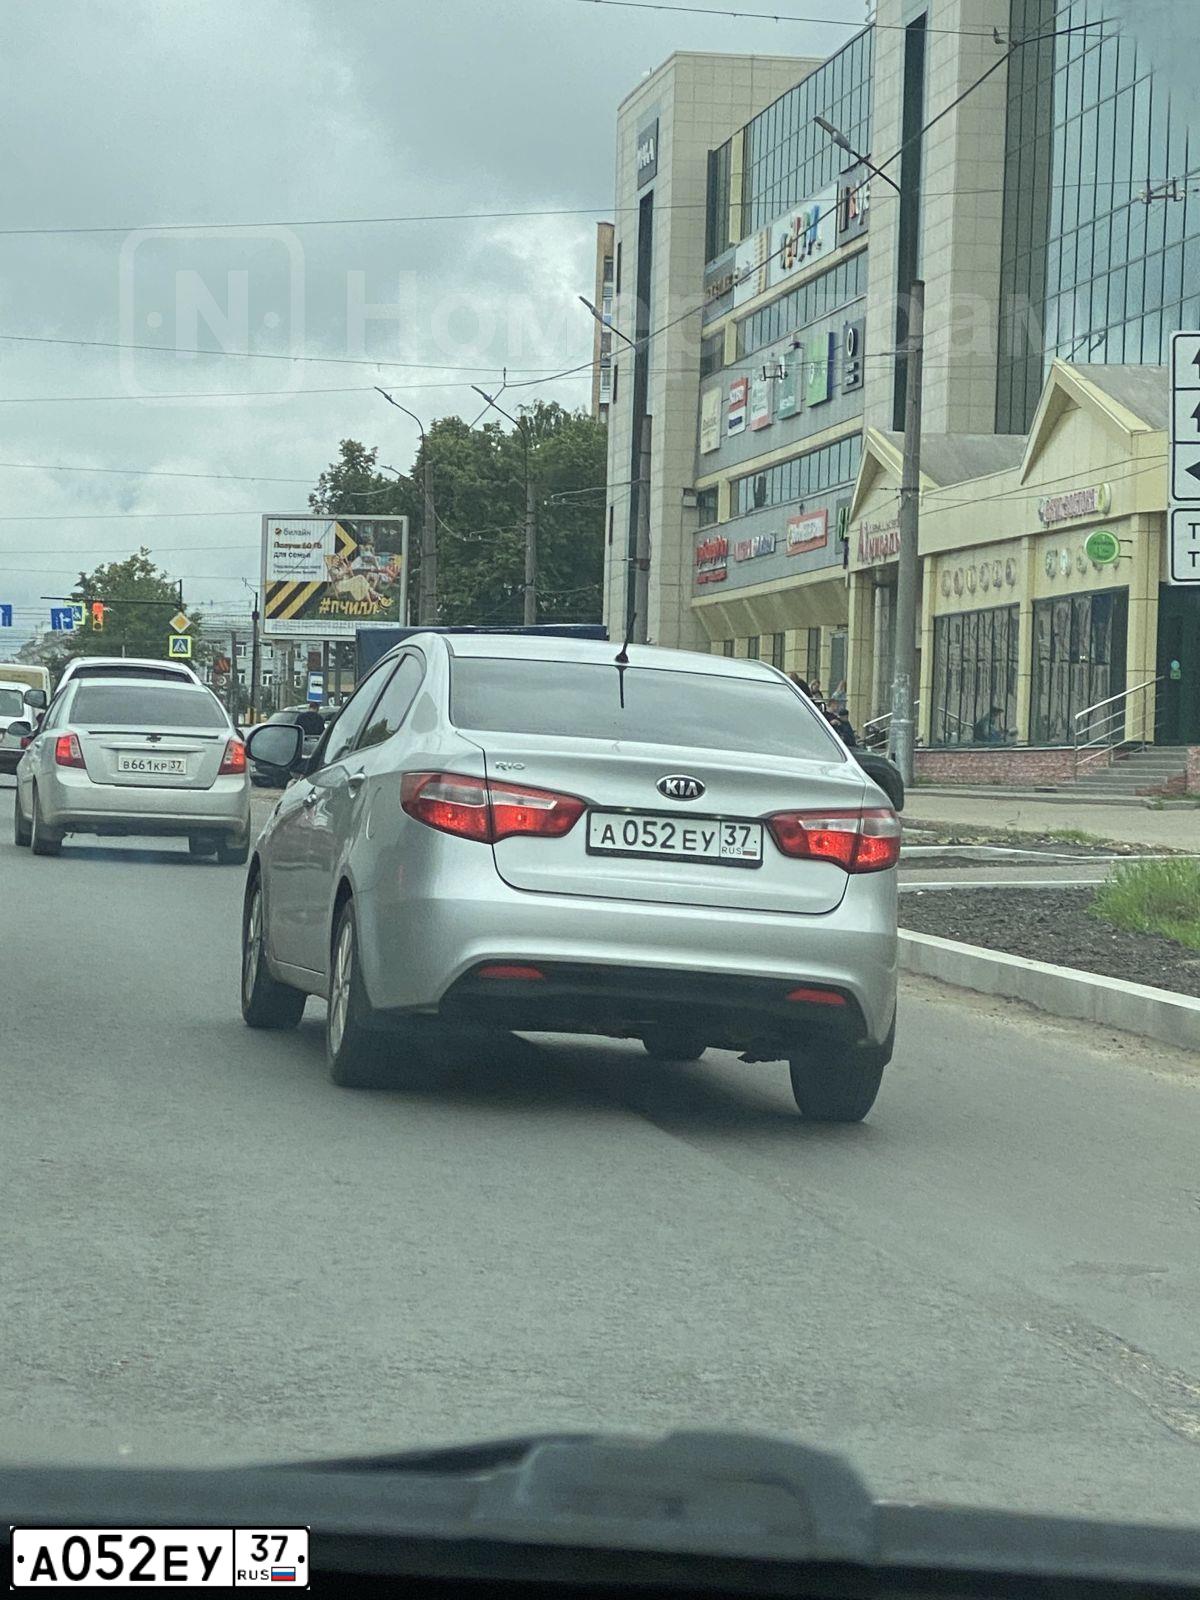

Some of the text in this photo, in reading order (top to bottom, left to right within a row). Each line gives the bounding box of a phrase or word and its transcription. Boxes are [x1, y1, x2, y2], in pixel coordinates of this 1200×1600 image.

[283, 527, 311, 536] билайн
[495, 761, 526, 771] RIO
[665, 779, 698, 796] KIA
[723, 824, 751, 848] 37
[721, 846, 742, 856] RUS
